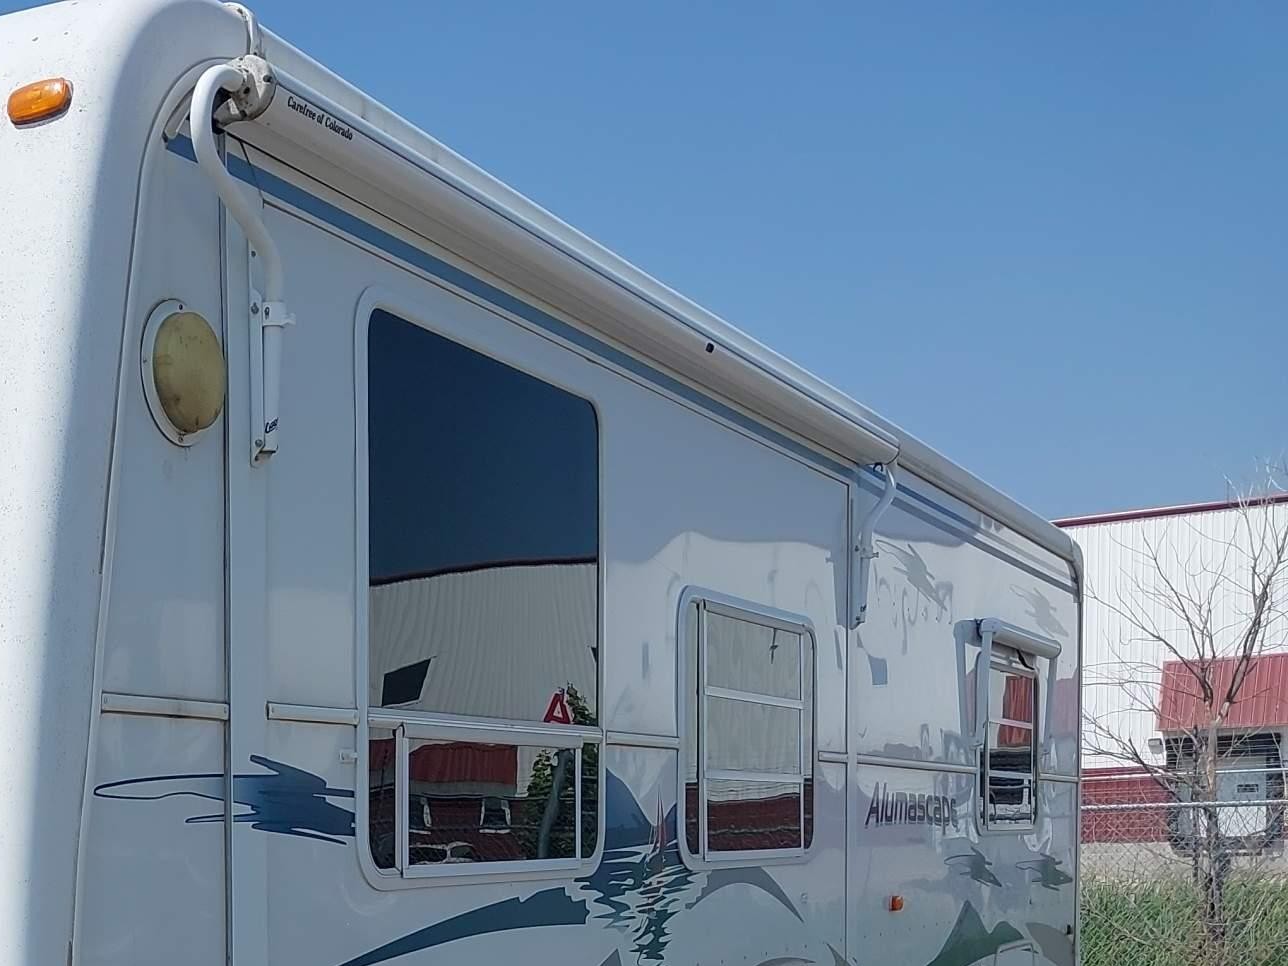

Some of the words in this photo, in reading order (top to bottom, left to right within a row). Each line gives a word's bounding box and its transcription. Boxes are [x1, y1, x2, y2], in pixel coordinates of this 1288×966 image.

[287, 95, 316, 121] Carefree
[316, 113, 325, 125] of
[325, 116, 353, 141] Colorado
[864, 781, 960, 836] Alumascape
